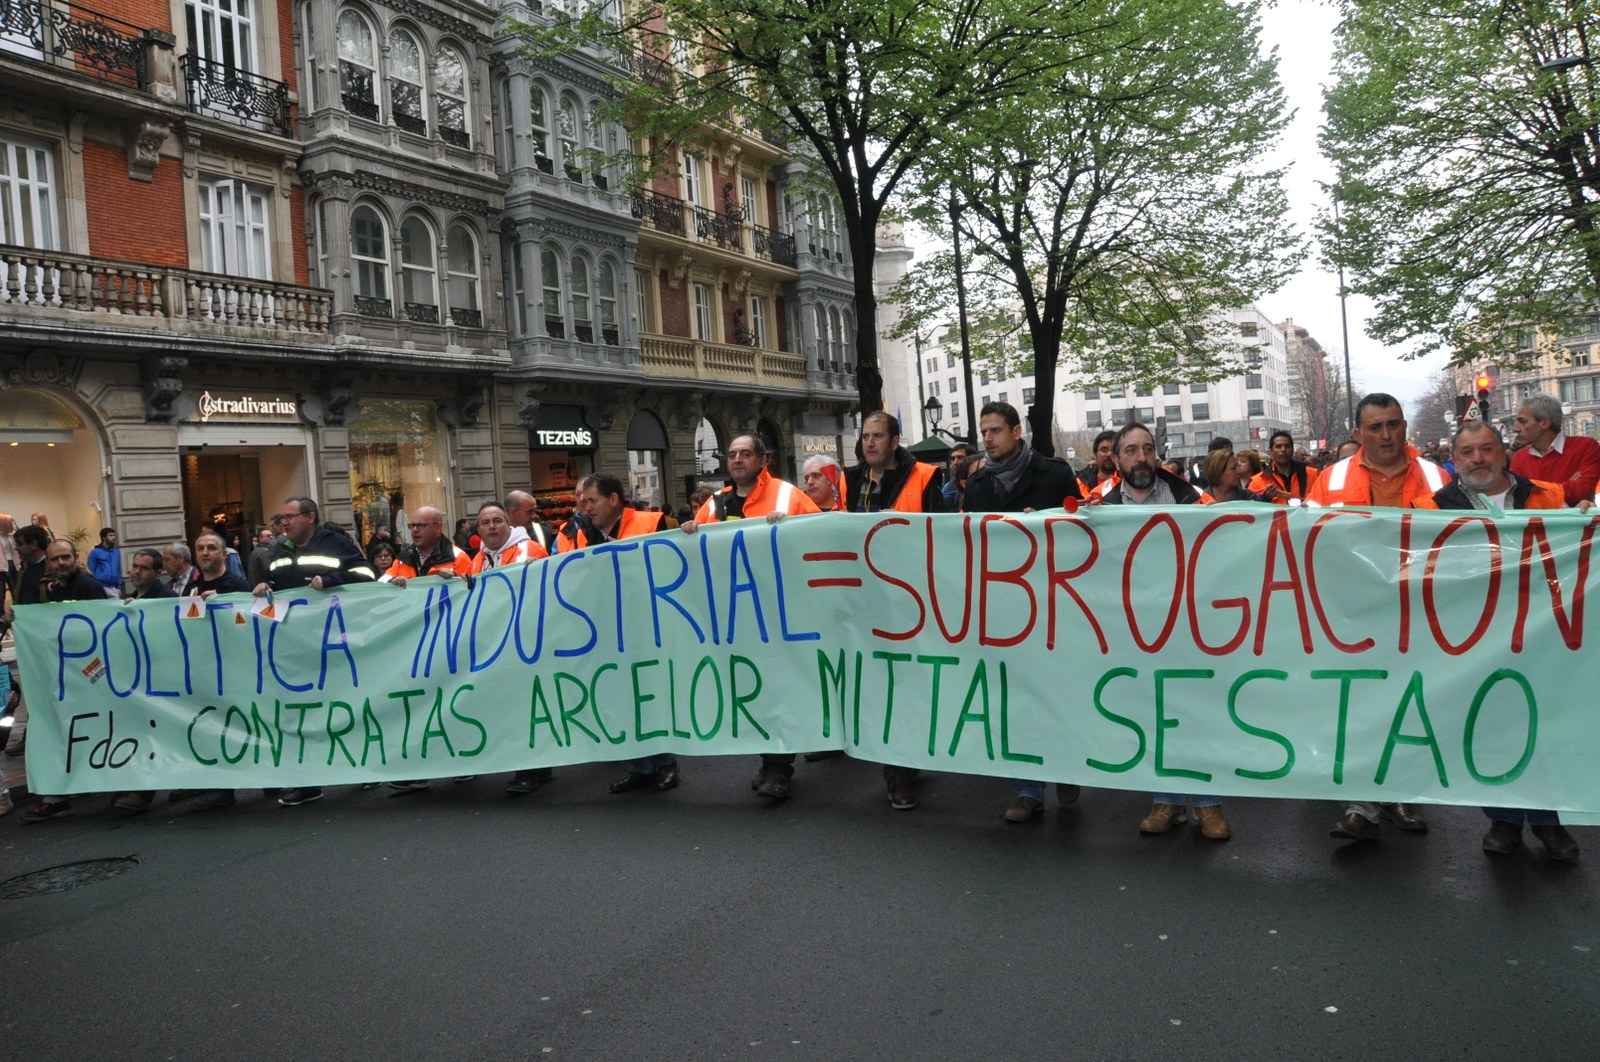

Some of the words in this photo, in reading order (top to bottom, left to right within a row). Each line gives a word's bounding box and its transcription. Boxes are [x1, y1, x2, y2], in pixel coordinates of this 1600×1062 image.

[58, 595, 359, 701] POLITICA
[411, 525, 821, 678] INDUSTRIAL
[187, 684, 488, 767] CONTRATAS
[529, 653, 770, 748] ARCELOR
[817, 647, 1044, 765] MITTAL
[1086, 666, 1538, 788] SESTAO
